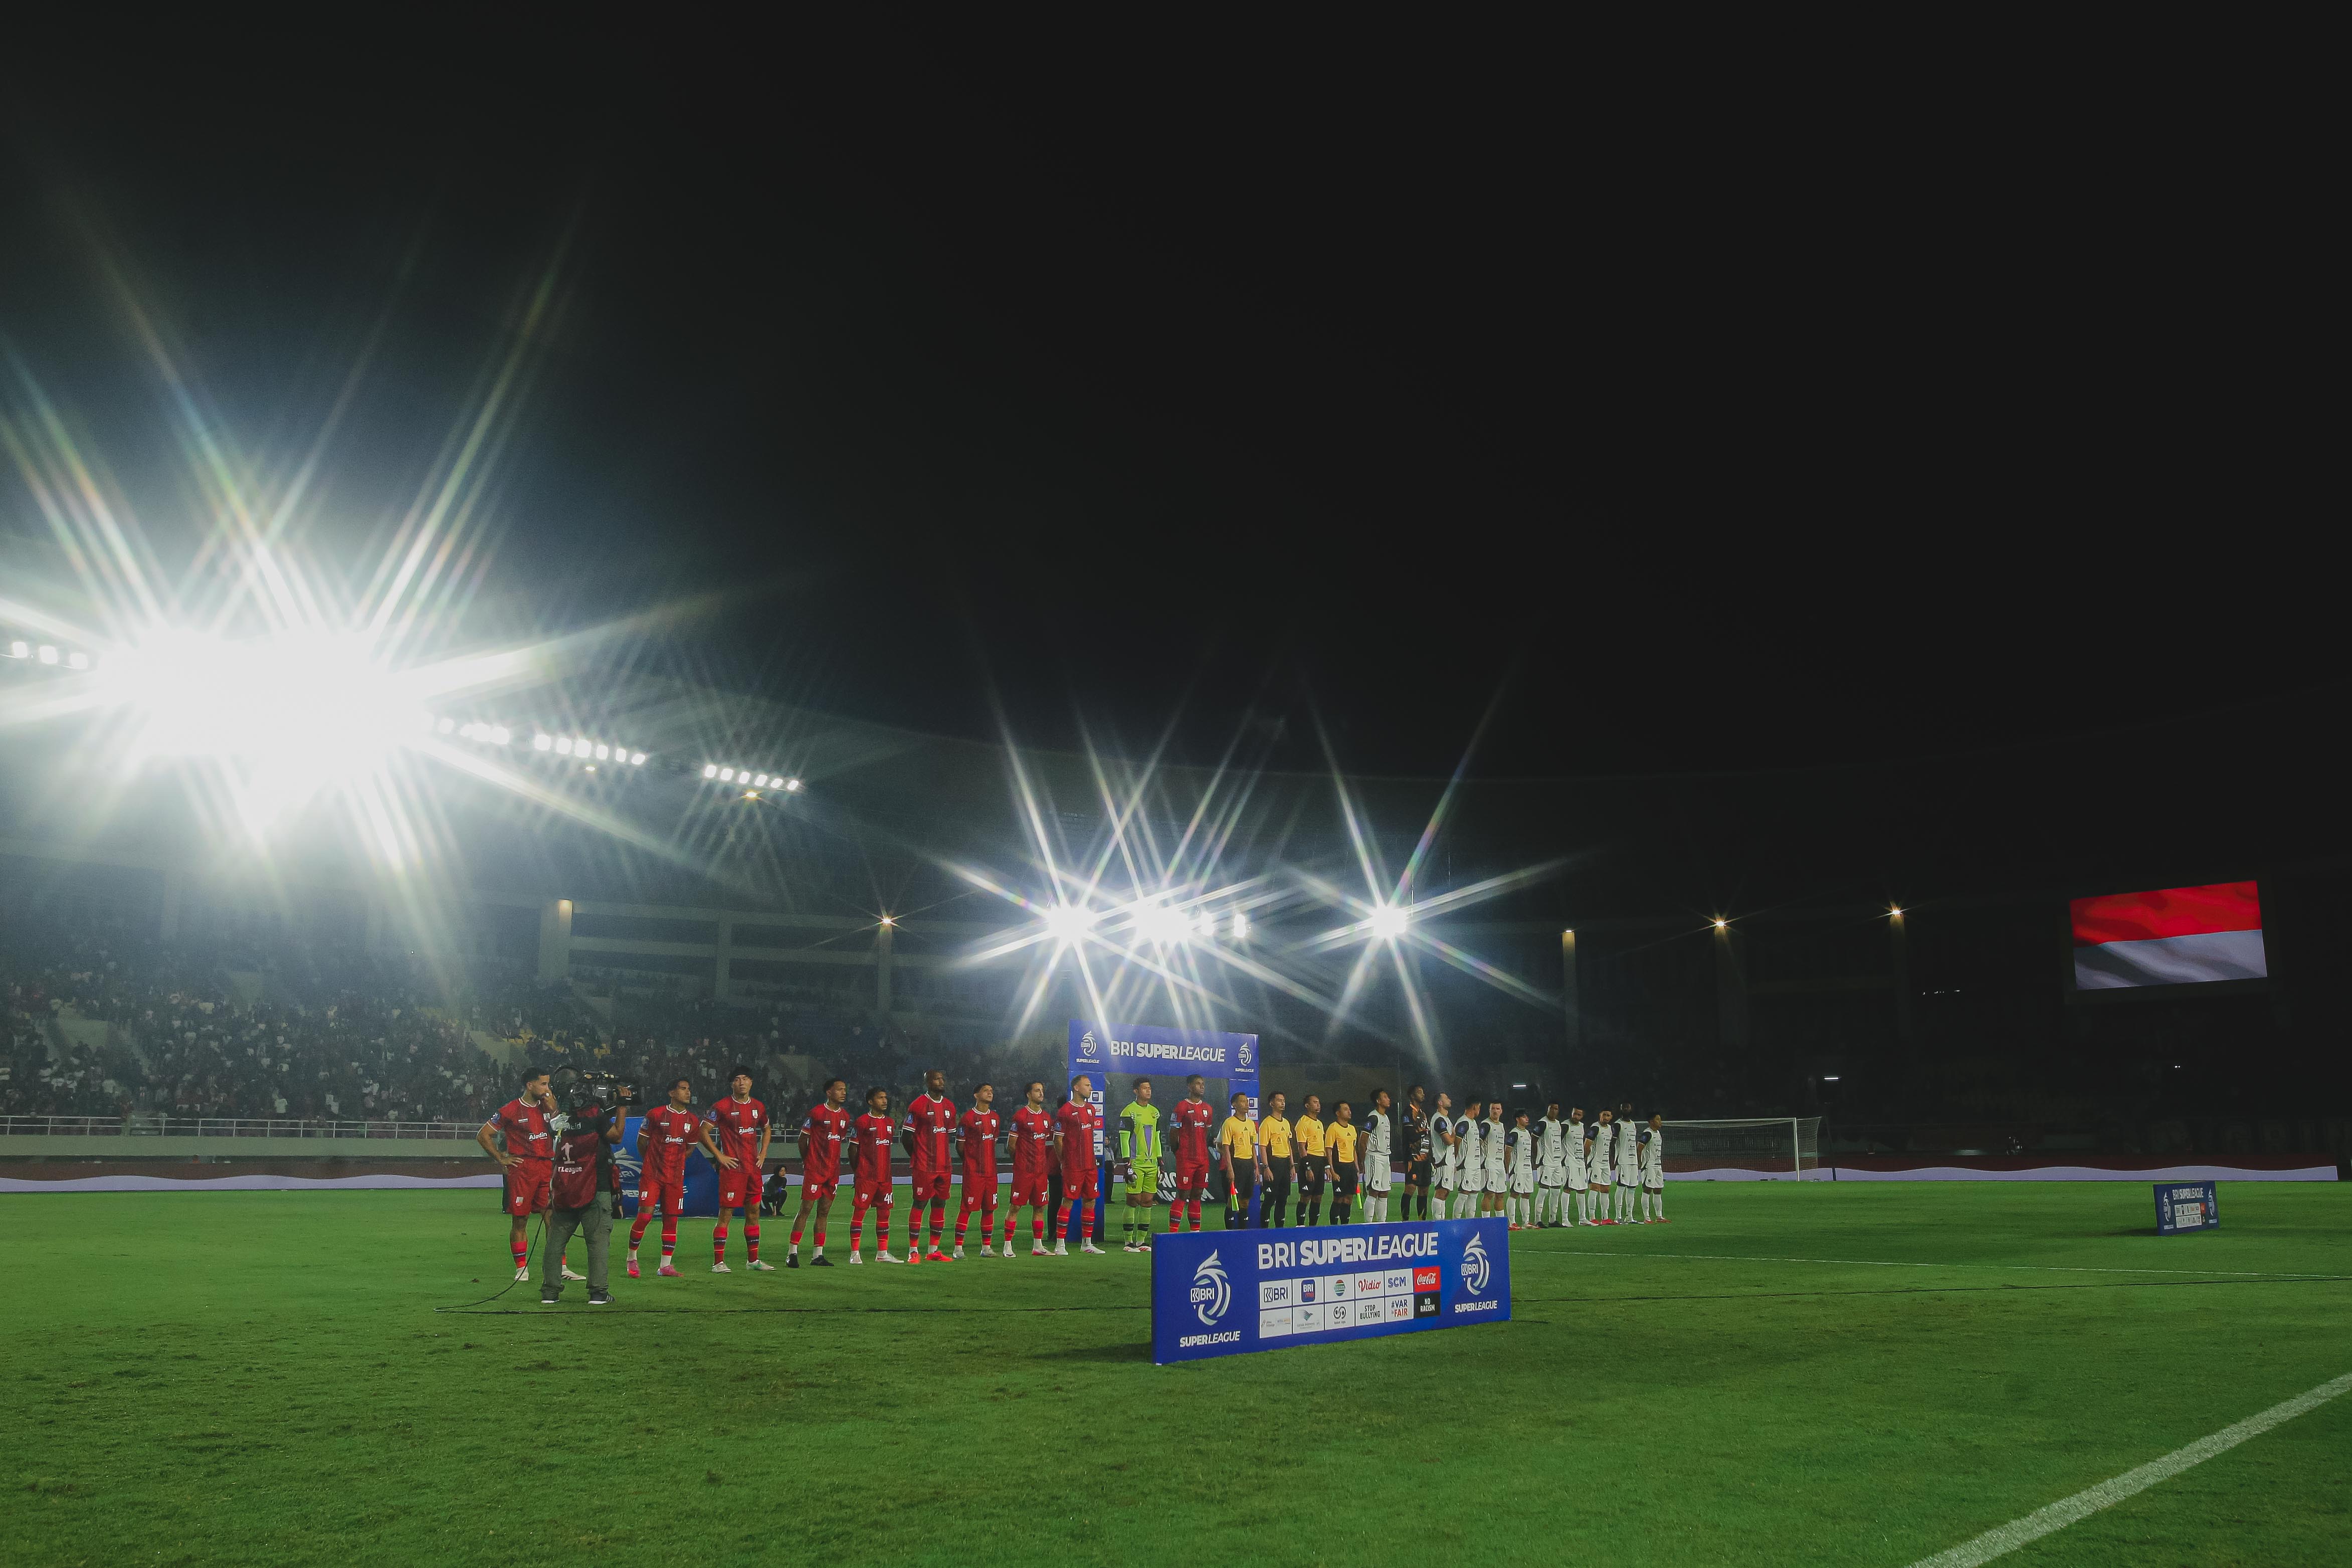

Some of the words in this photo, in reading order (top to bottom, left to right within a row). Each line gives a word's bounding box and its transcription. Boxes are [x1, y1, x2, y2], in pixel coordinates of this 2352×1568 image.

[1110, 1041, 1134, 1056] BRI
[1136, 1043, 1226, 1062] SUPERLEAGUE
[529, 1132, 547, 1140] Aladin
[1258, 1242, 1295, 1270] BRI
[1300, 1232, 1439, 1266] SUPERLEAGUE
[1358, 1279, 1381, 1292] Vidio
[1388, 1276, 1407, 1288] SCM
[1303, 1284, 1313, 1292] BRI
[1274, 1287, 1288, 1301] BRI
[1364, 1304, 1376, 1312] STOP
[1391, 1299, 1408, 1308] #VAR
[1420, 1304, 1435, 1312] RACISM
[1455, 1300, 1498, 1313] SUPERLEAGUE
[1360, 1311, 1381, 1319] BULLYING
[1395, 1308, 1408, 1317] FAIR
[1180, 1331, 1241, 1347] SUPERLEAGUE
